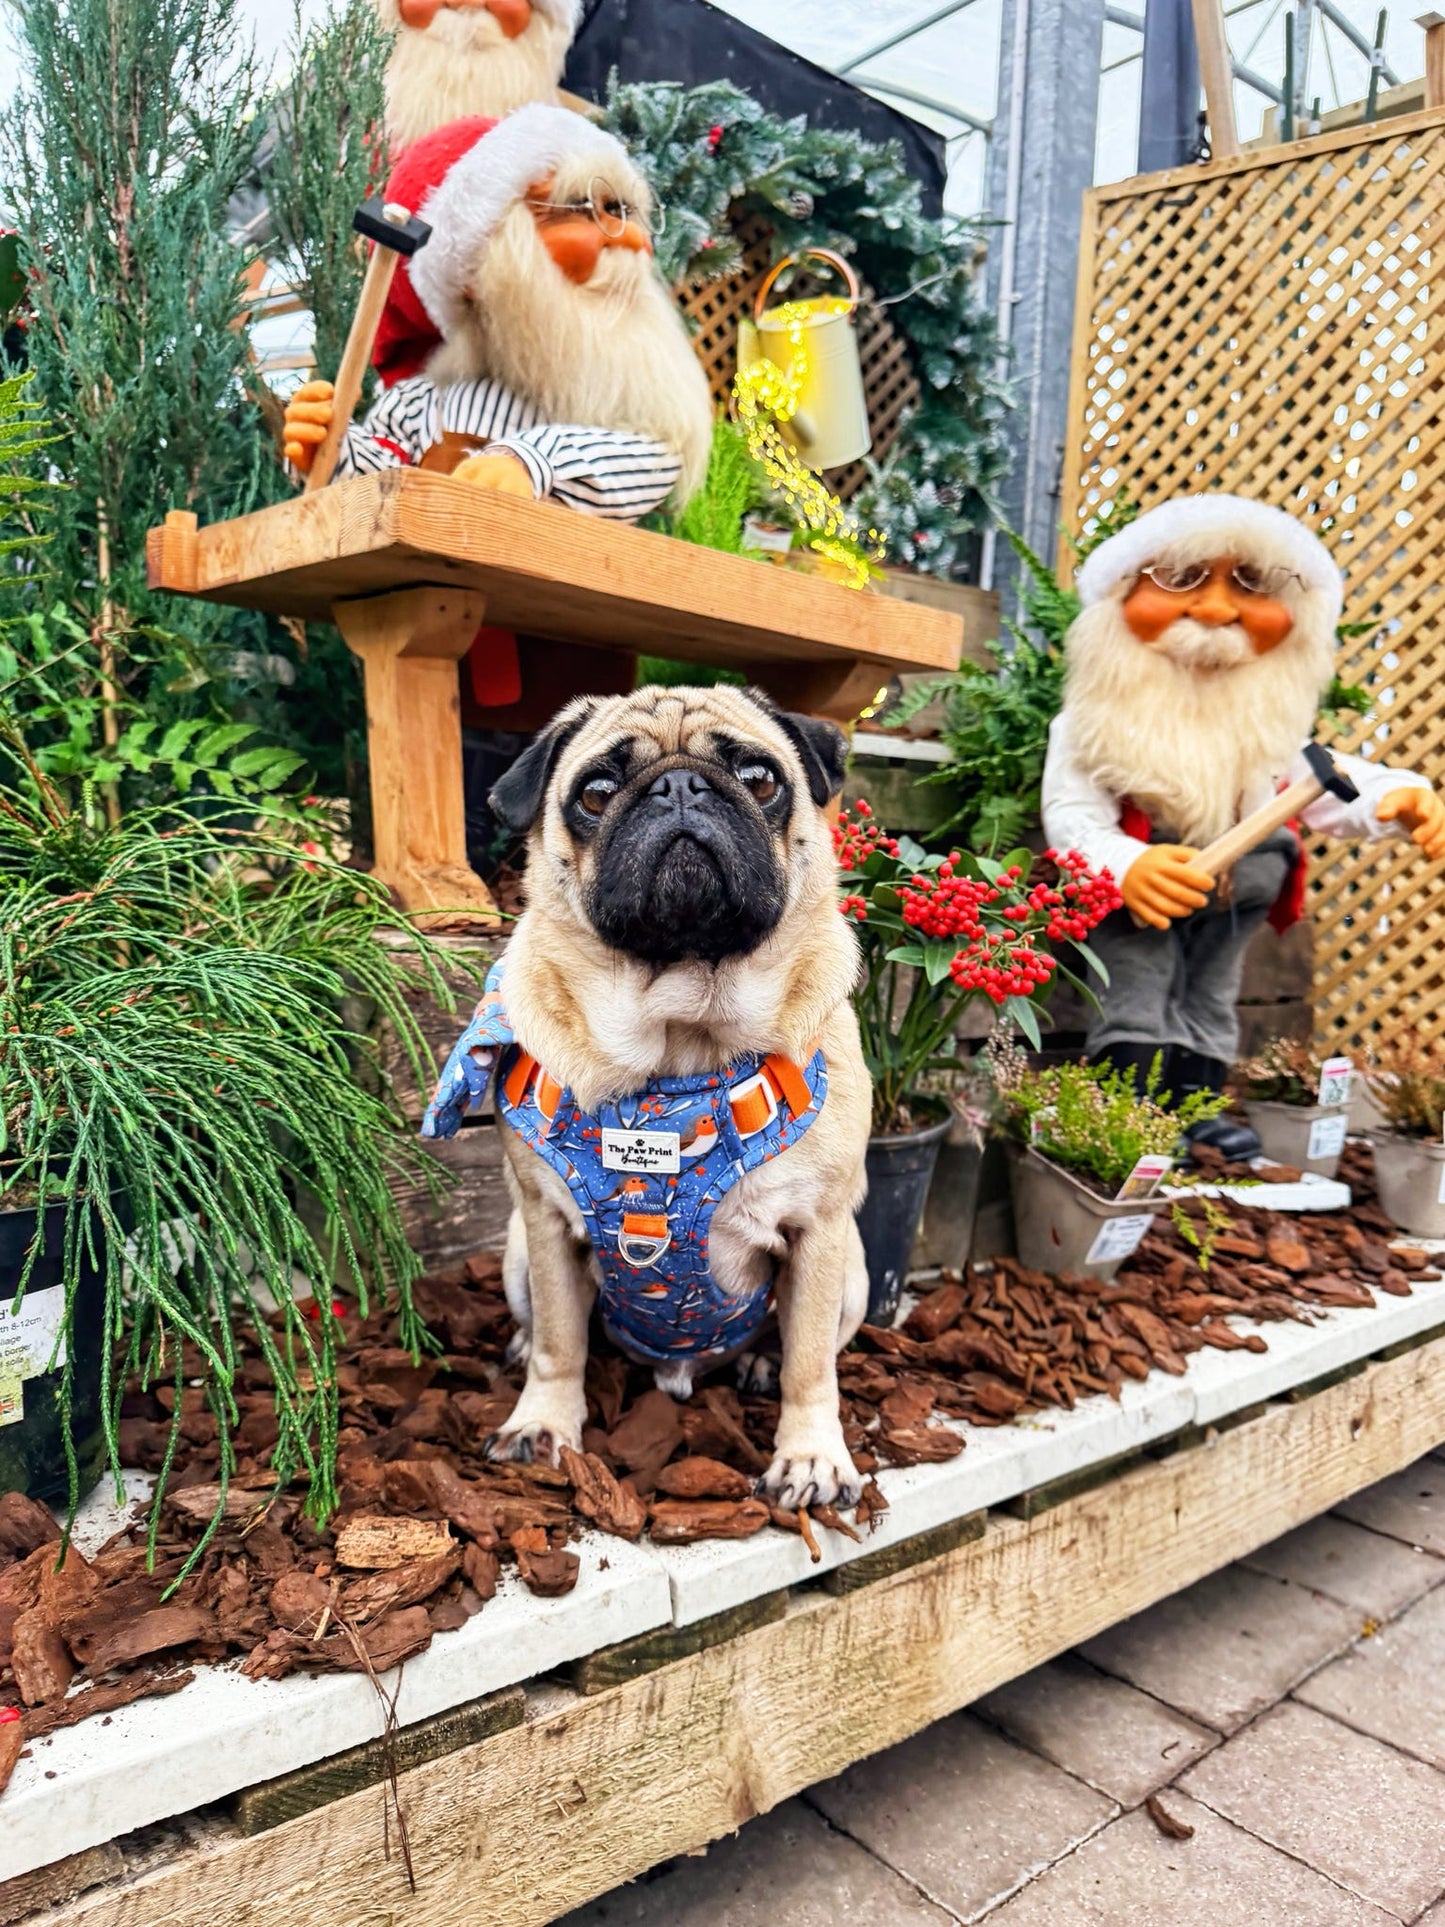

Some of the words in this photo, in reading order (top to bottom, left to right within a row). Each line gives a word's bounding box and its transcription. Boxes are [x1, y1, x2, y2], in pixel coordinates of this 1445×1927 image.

[608, 1144, 625, 1153] The
[628, 1146, 647, 1154] Paw
[648, 1147, 673, 1156] Print
[621, 1153, 659, 1168] Boutique
[11, 1317, 42, 1330] 8-12cm
